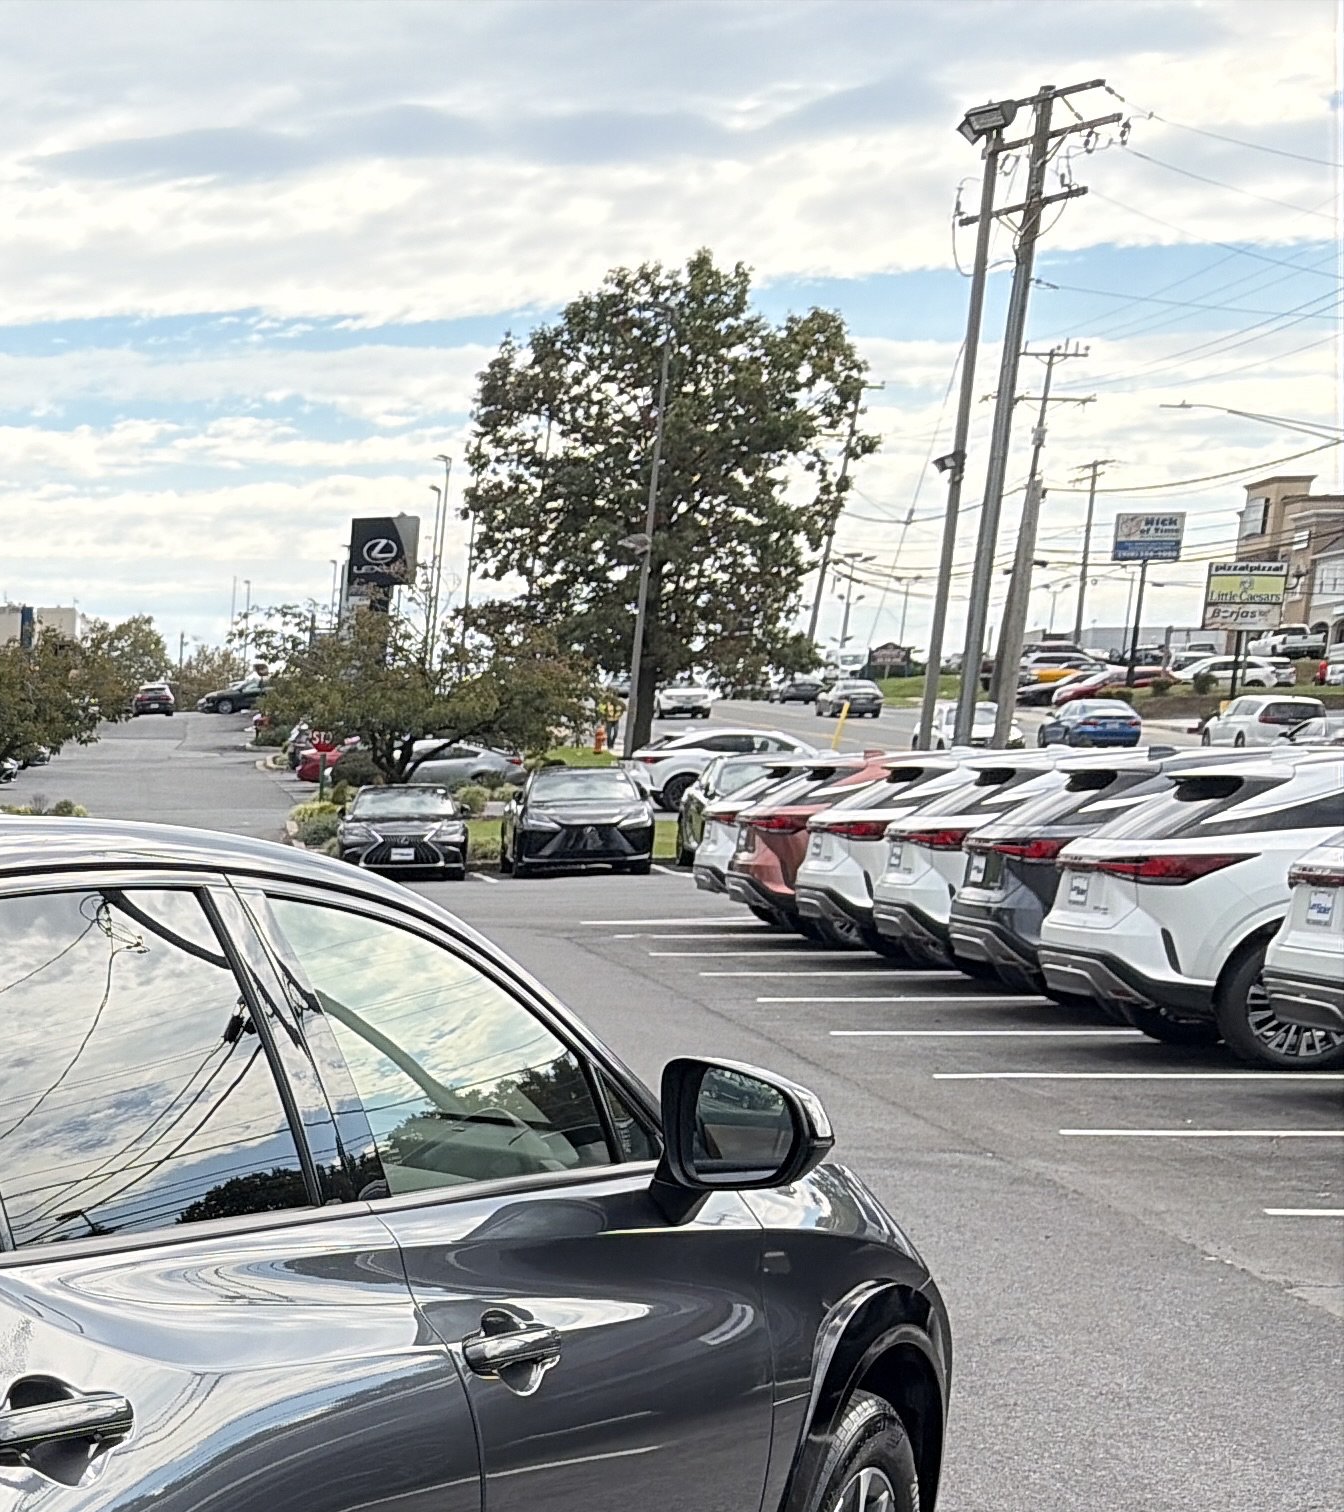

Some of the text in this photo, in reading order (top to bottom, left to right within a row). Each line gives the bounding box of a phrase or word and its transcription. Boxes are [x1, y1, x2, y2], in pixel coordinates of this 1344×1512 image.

[353, 565, 402, 574] LEX
[1209, 590, 1281, 601] Little Caesars
[312, 731, 340, 744] STO
